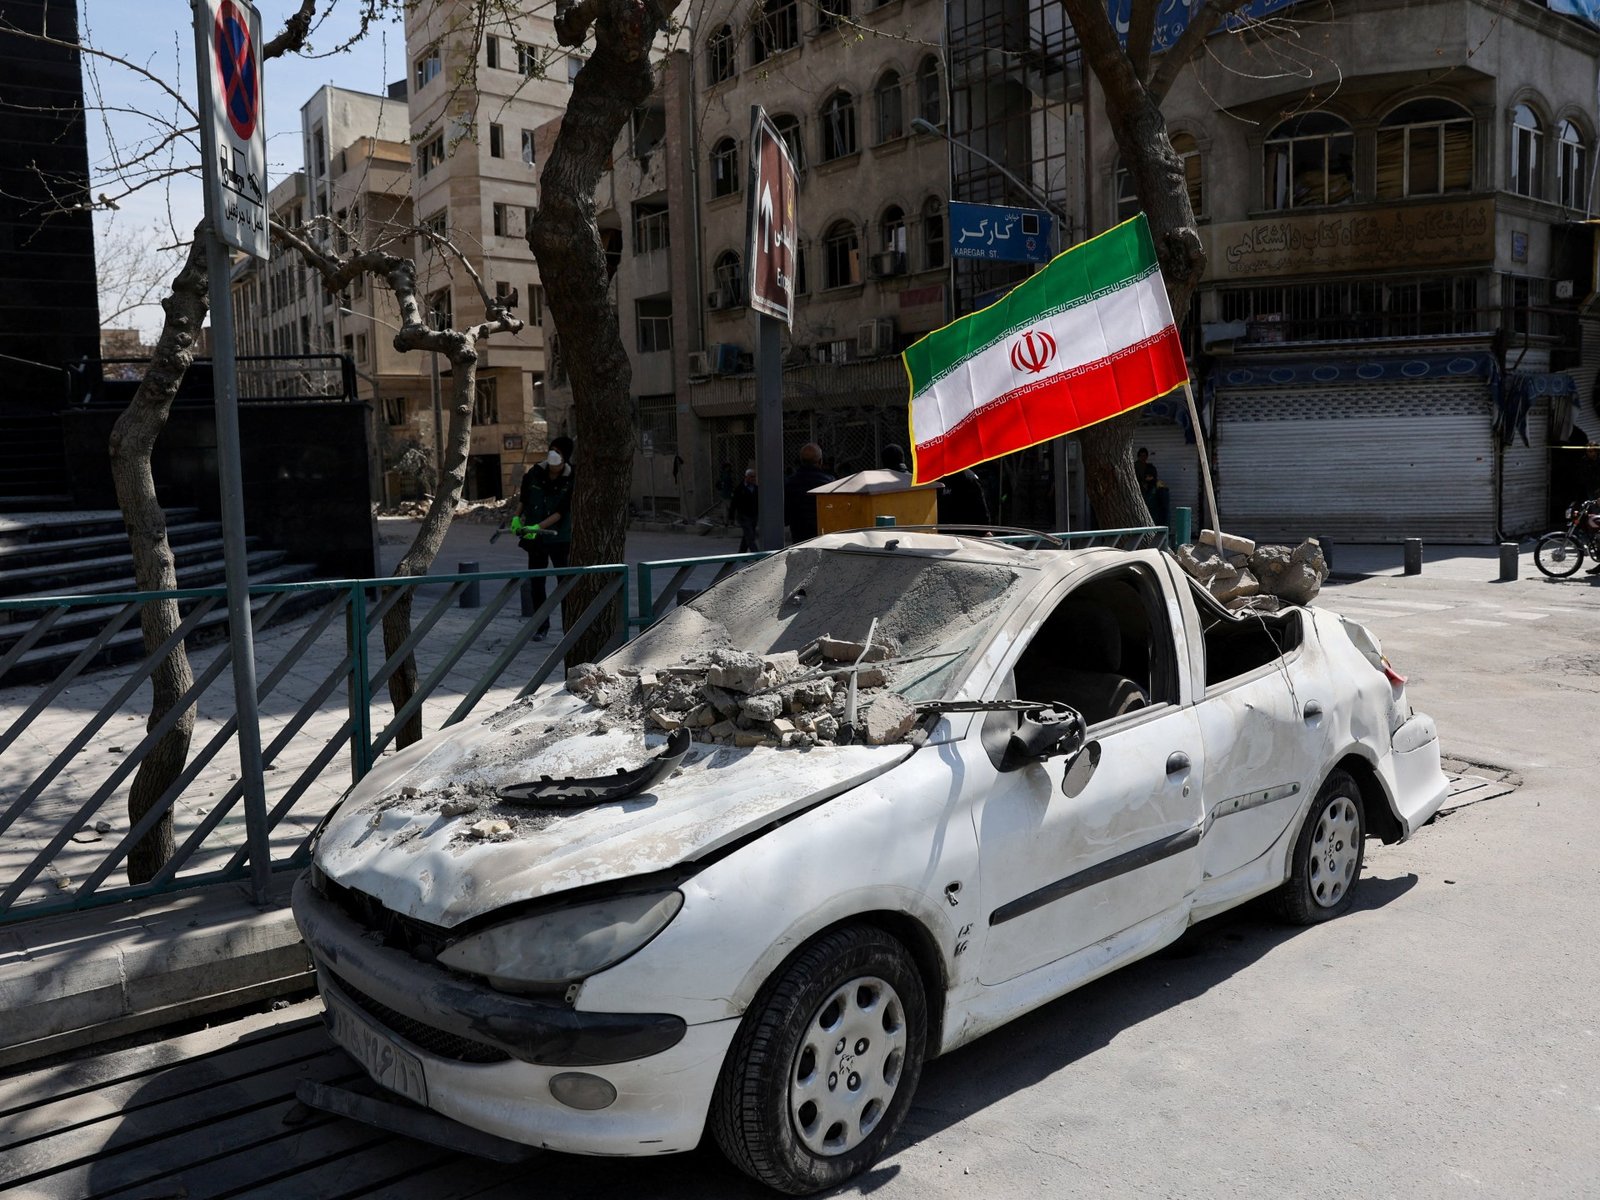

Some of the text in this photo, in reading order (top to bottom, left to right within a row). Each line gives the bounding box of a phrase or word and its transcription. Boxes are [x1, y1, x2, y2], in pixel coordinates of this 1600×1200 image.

[958, 219, 1014, 246] کارگر
[1226, 223, 1300, 263] دانشگاهی
[1303, 219, 1341, 256] کتاب
[1415, 206, 1487, 245] نمایشگاه
[954, 247, 1000, 259] KAREGAR ST.
